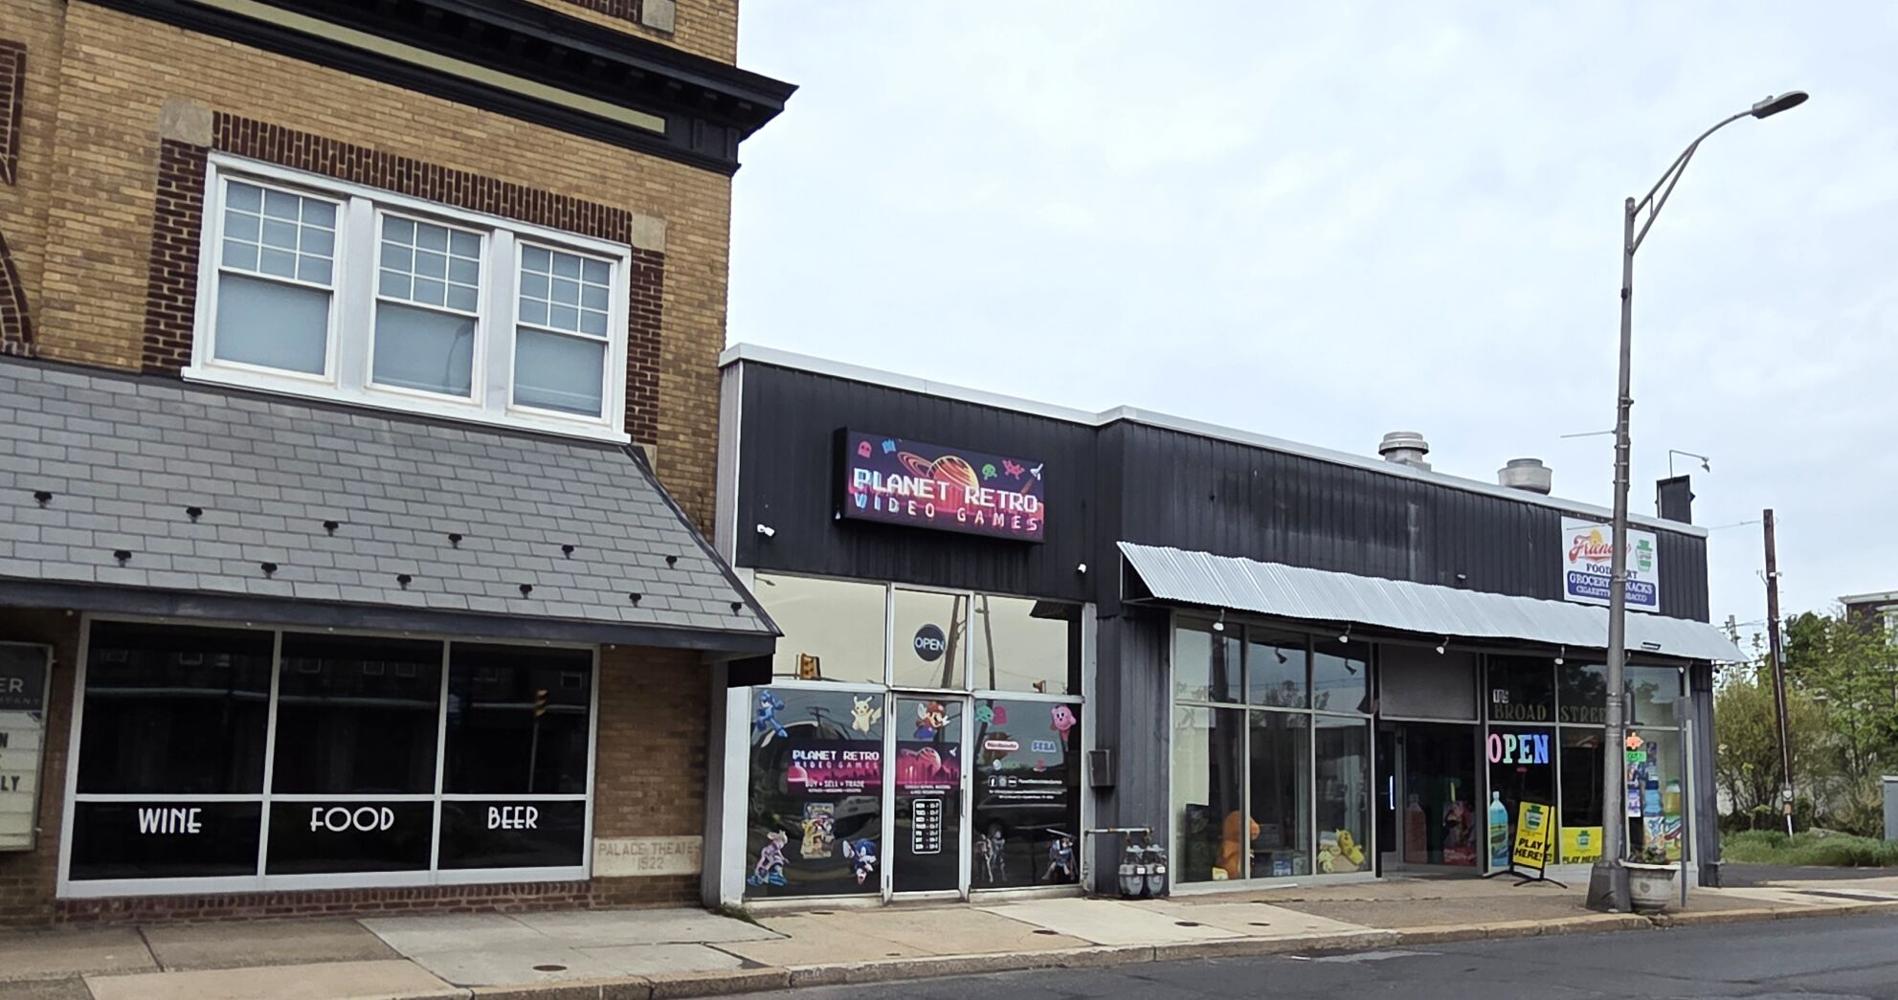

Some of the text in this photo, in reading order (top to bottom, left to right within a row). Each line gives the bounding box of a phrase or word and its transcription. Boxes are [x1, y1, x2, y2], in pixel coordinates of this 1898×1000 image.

[853, 467, 1038, 513] PLANET RETRO
[854, 492, 1038, 531] VIDEO GAMES
[1625, 581, 1653, 595] NACKS
[915, 637, 945, 651] OPEN
[1494, 703, 1547, 720] BROAD
[1561, 705, 1607, 722] STREE
[792, 749, 879, 760] PLANET RETRO
[1488, 733, 1549, 764] OPEN
[138, 807, 202, 834] WINE
[310, 806, 395, 832] FOOD
[487, 806, 539, 829] BEER
[598, 842, 646, 857] PALACE
[1518, 837, 1544, 850] PLAY
